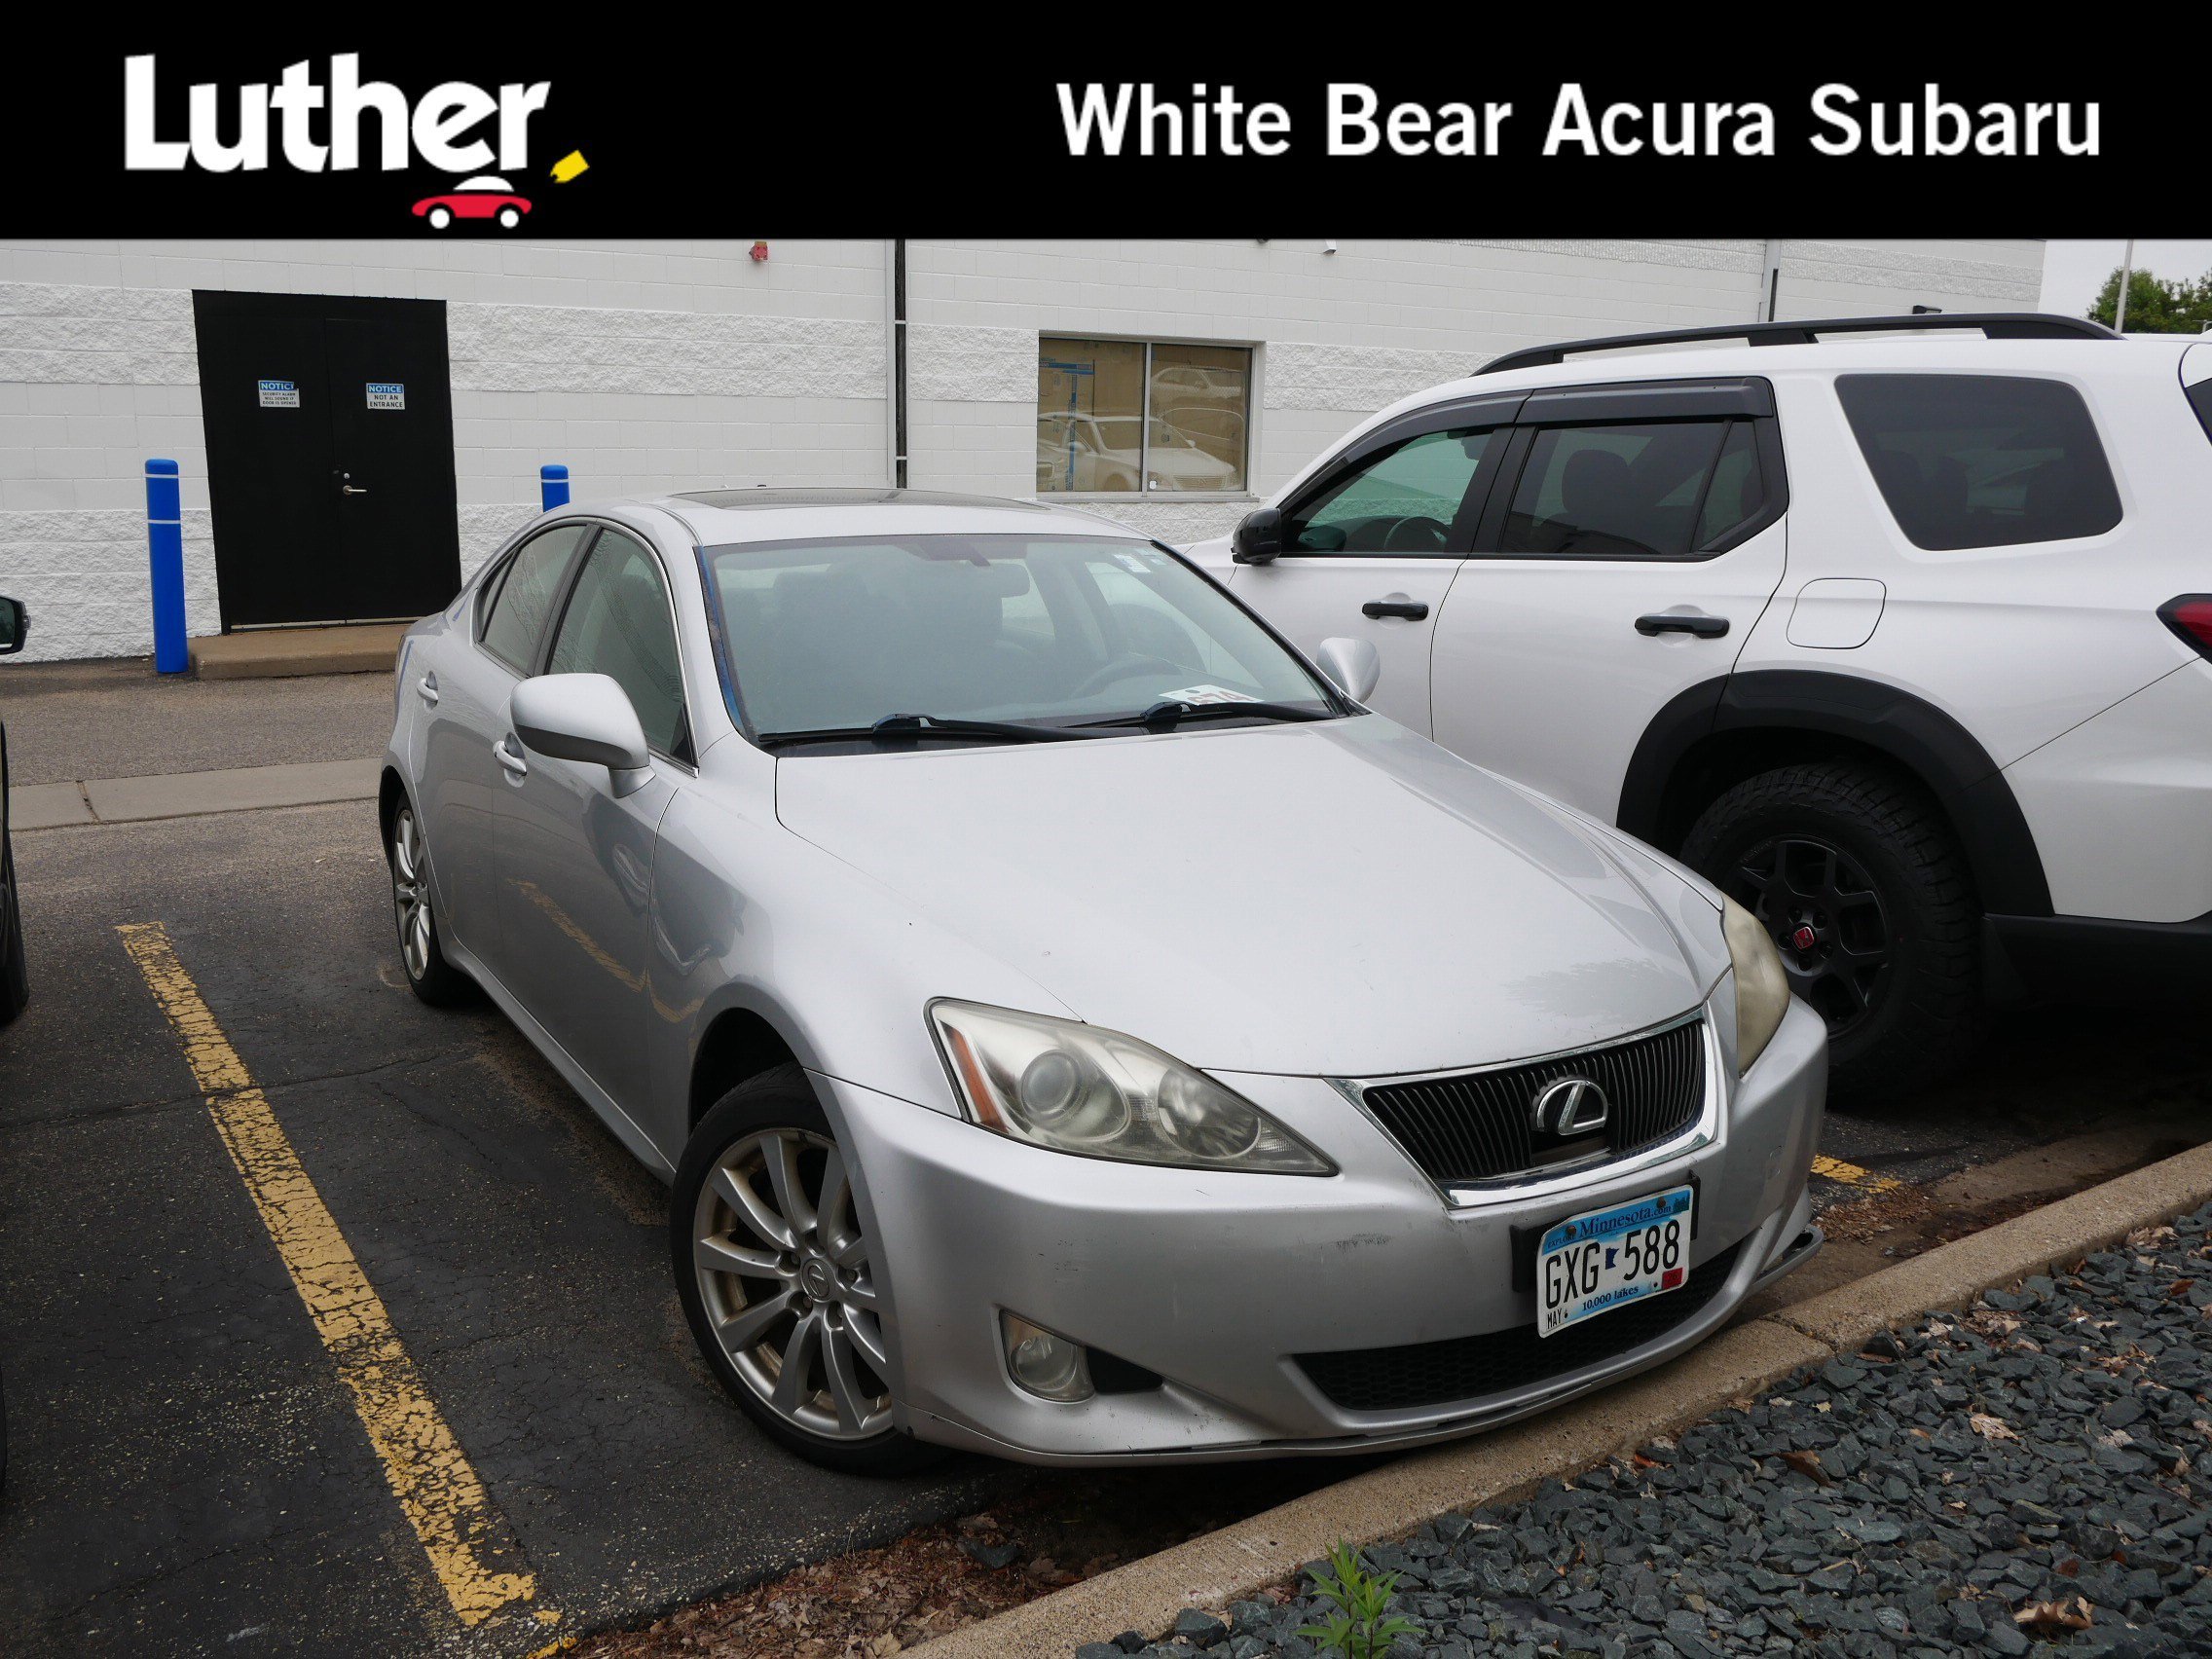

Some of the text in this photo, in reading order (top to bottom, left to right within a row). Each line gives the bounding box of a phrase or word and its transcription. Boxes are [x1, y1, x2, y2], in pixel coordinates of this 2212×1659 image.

[1545, 1219, 1680, 1309] GXG 588
[1582, 1285, 1640, 1311] 10,000 lakes
[1547, 1308, 1563, 1329] MAY
